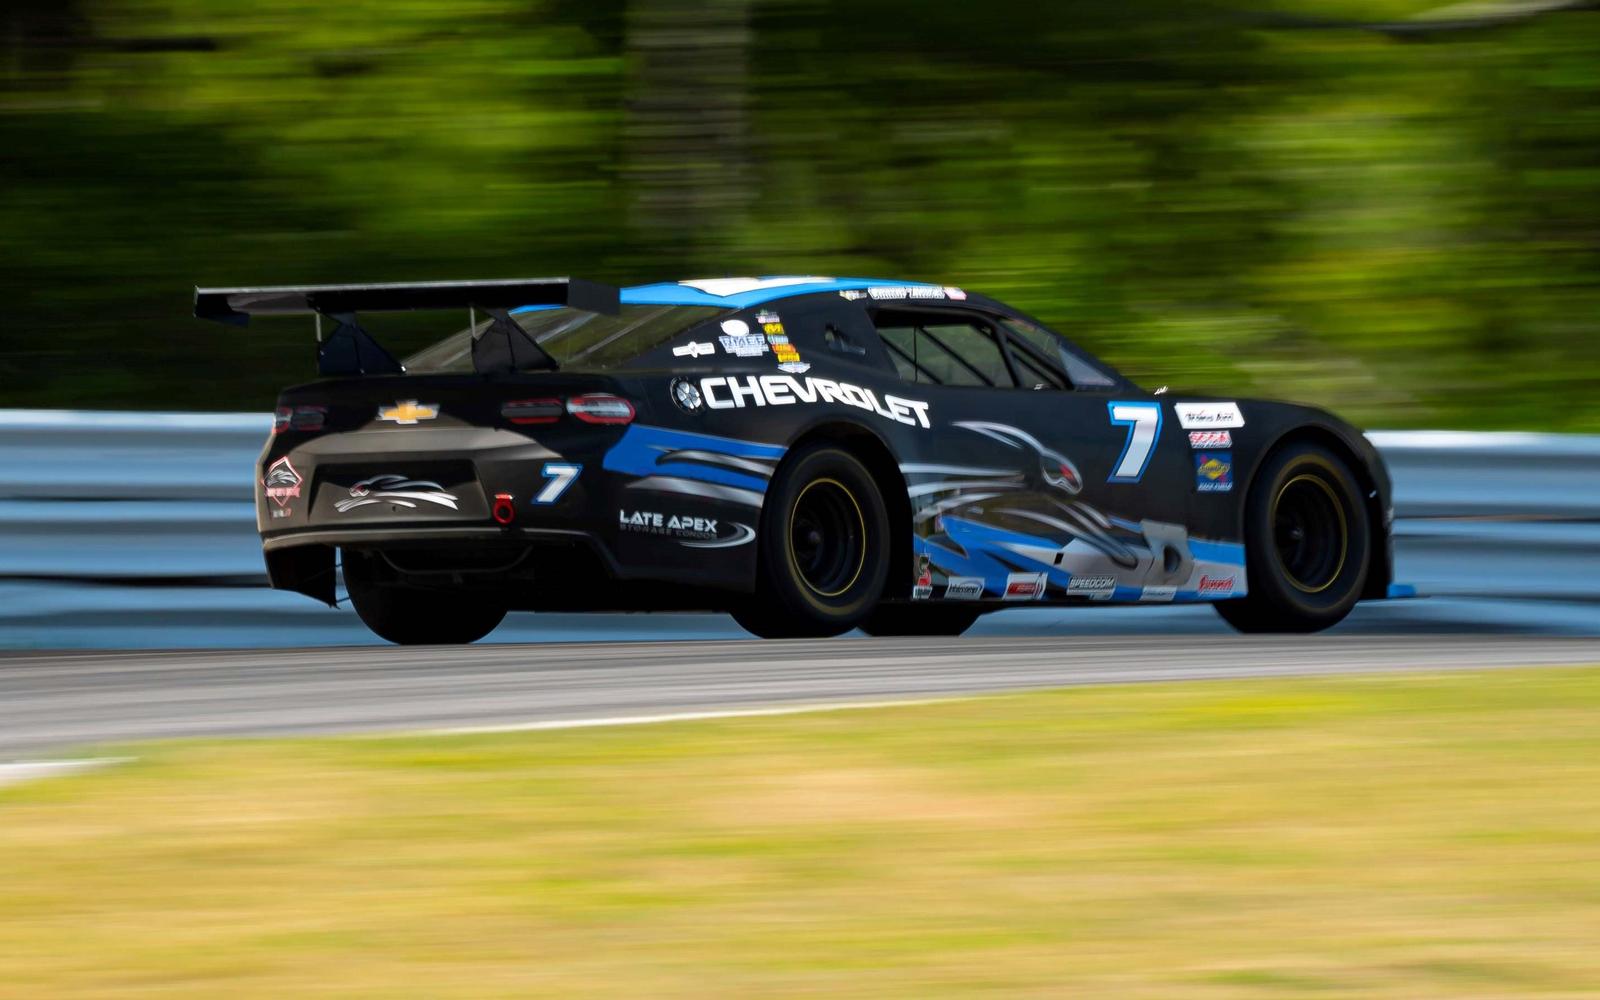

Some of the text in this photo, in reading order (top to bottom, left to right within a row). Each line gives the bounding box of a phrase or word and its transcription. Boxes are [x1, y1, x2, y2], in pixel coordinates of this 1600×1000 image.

[700, 375, 931, 429] CHEVROLET
[1106, 401, 1163, 483] 7
[531, 462, 583, 504] 7
[619, 509, 718, 533] LATE APEX
